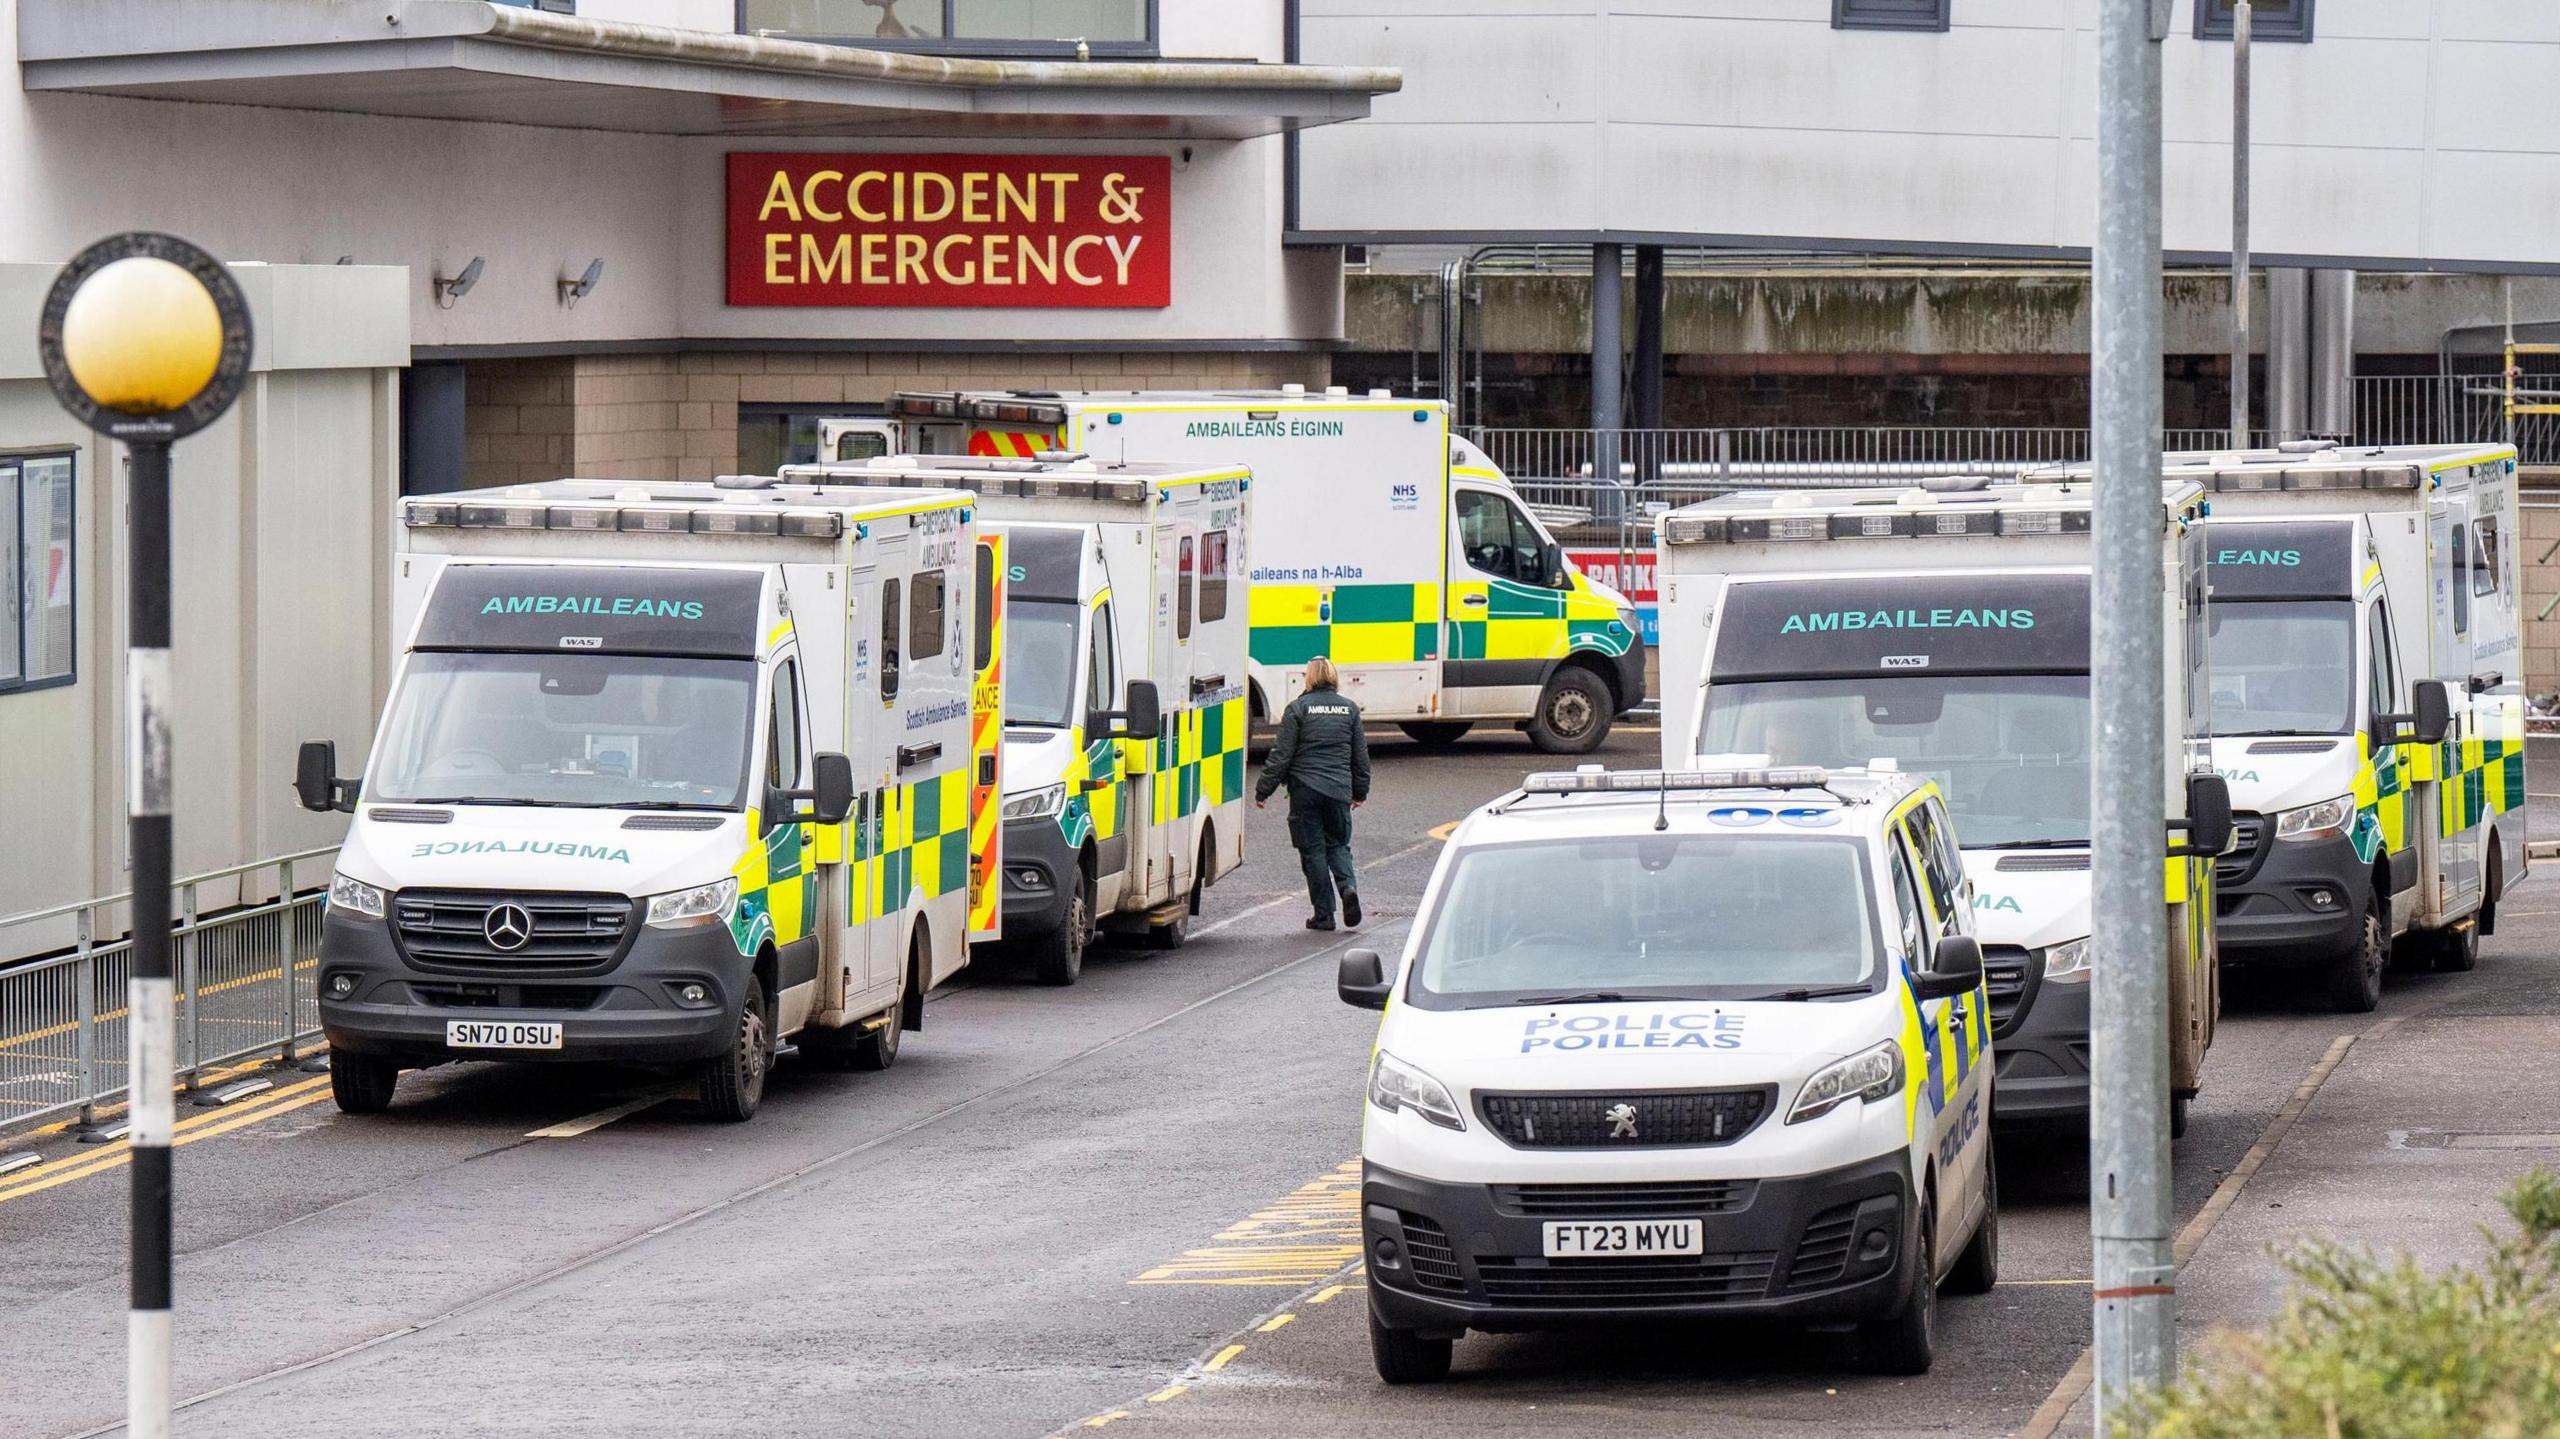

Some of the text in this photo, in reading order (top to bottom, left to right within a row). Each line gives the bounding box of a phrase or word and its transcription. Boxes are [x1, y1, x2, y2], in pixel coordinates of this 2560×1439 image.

[757, 169, 1145, 225] ACCIDENT &
[764, 233, 1143, 286] EMERGENCY
[1185, 421, 1286, 438] AMBAILEANS
[1393, 484, 1417, 496] NHS
[1302, 567, 1318, 580] na
[1322, 565, 1363, 580] h-Alba
[480, 596, 704, 620] AMBAILEANS
[1780, 608, 2034, 634] AMBAILEANS
[565, 638, 595, 646] WAS
[1887, 657, 1921, 666] WAS
[906, 697, 967, 731] Scottish Ambulance Service
[1307, 705, 1350, 715] AMBULANCE
[456, 1024, 552, 1045] SN70 OSU
[1524, 1014, 1746, 1036] POLICE
[1520, 1032, 1742, 1053] POILEAS
[1940, 1087, 1980, 1167] POLICE
[1556, 1224, 1689, 1251] FT23 MYU
